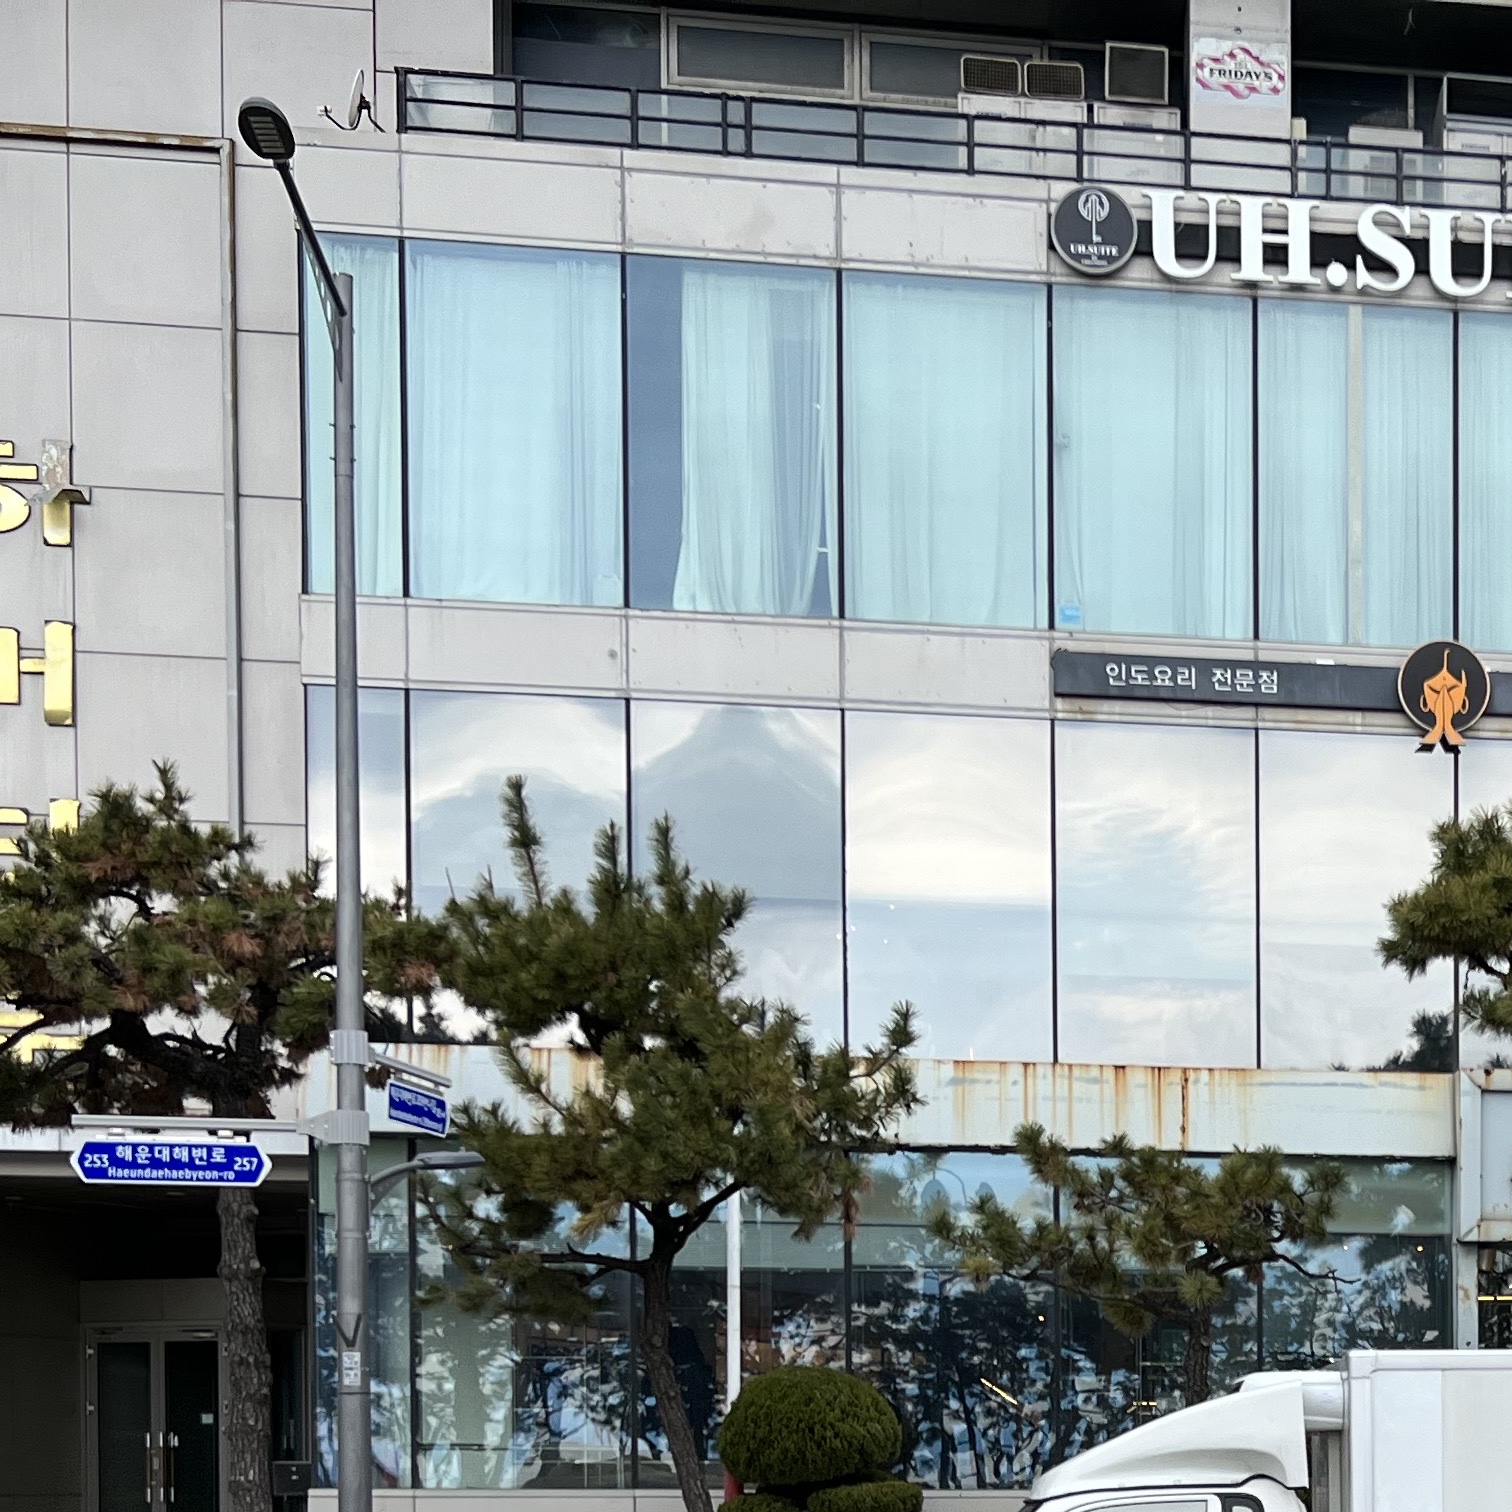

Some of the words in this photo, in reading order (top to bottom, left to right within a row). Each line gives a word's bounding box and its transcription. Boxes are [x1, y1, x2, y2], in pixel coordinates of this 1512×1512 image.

[1105, 662, 1196, 690] 인도요리
[1211, 667, 1279, 694] 전문점
[84, 1153, 110, 1168] 253
[115, 1145, 228, 1165] 해운대해변로
[233, 1157, 259, 1172] 257
[108, 1166, 236, 1181] Haeundaehaebyeon-ro
